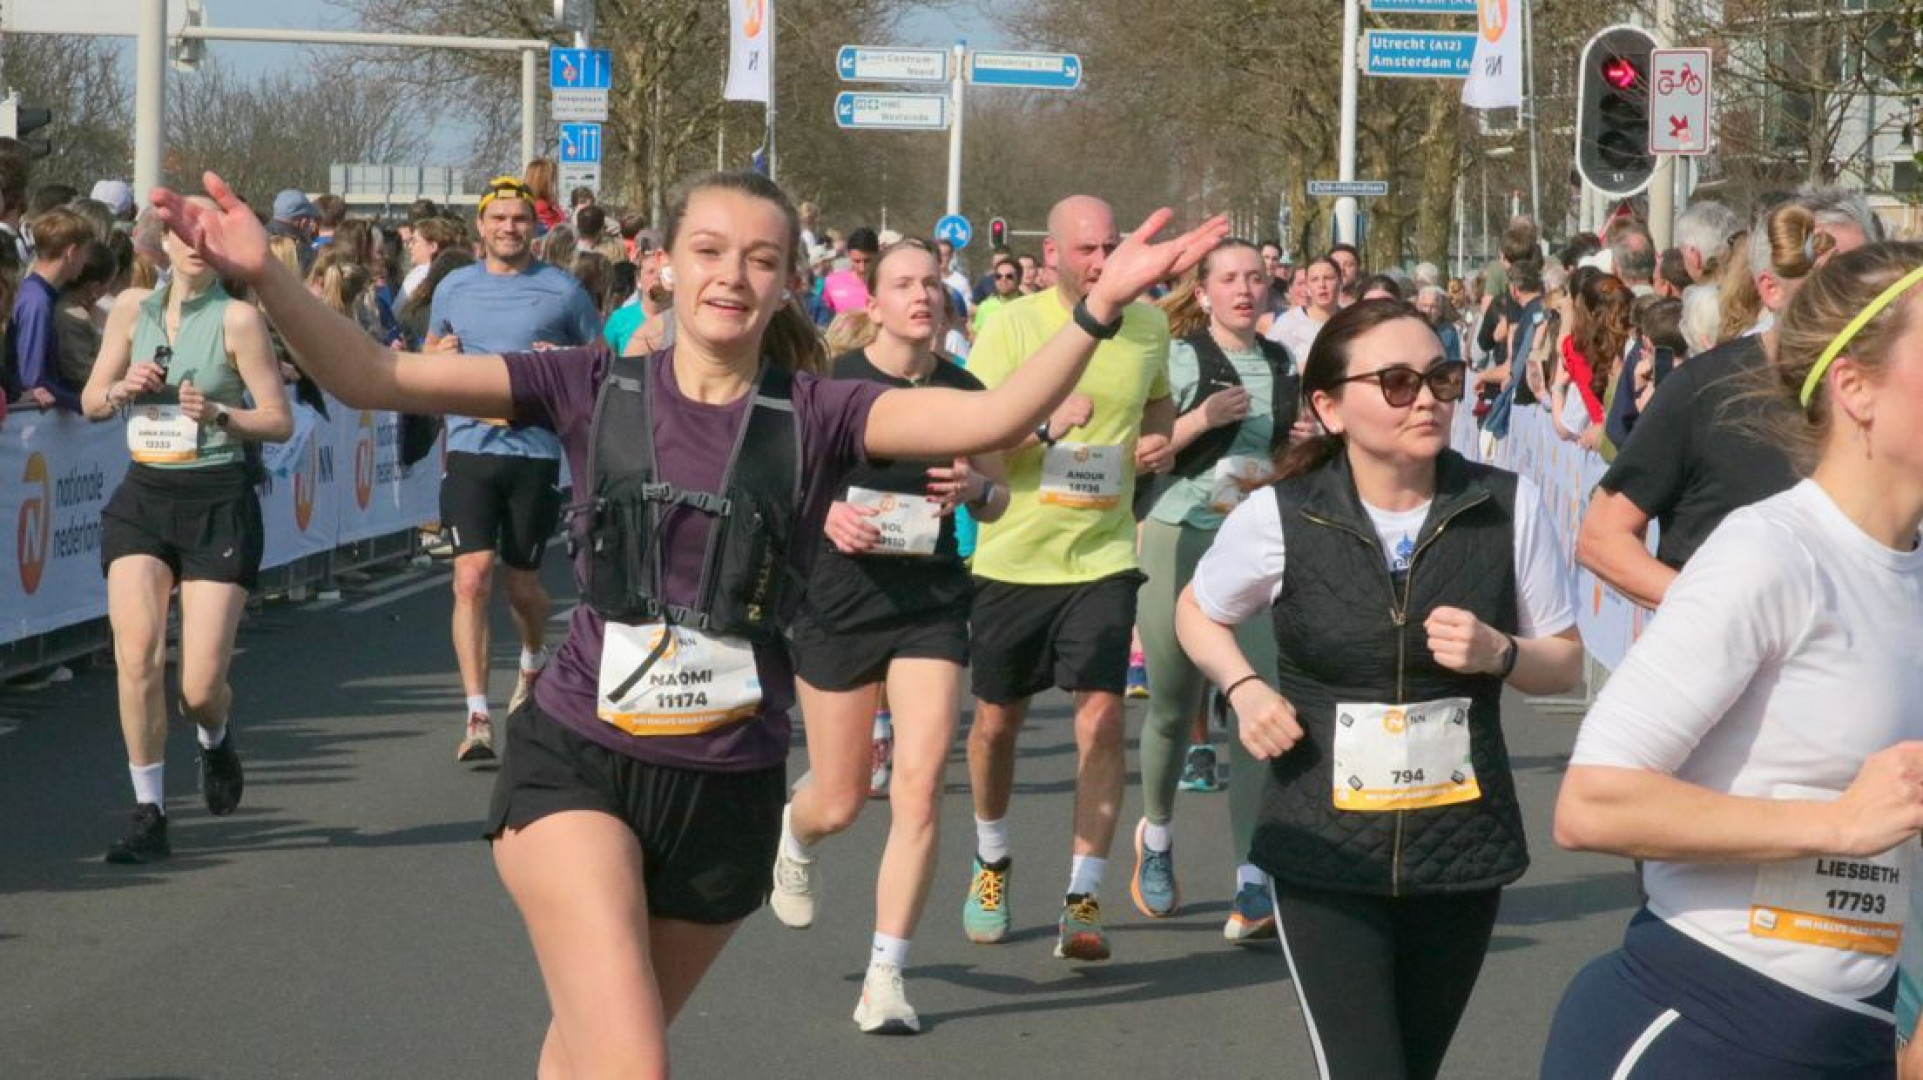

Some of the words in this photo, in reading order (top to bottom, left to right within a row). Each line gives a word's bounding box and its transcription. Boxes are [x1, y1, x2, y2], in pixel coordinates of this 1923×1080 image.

[1371, 37, 1425, 50] Utrecht
[1429, 39, 1461, 51] (A12)
[1371, 55, 1451, 69] Amsterdam
[1455, 58, 1472, 70] (A
[318, 445, 333, 482] NN
[1067, 471, 1104, 480] ANOUK
[55, 461, 104, 508] nationale
[53, 513, 102, 560] nederlan
[650, 669, 712, 685] NAOMI
[655, 692, 708, 707] 11174
[1391, 769, 1424, 784] 794
[1816, 858, 1900, 883] LIESBETH
[1825, 889, 1886, 914] 17793
